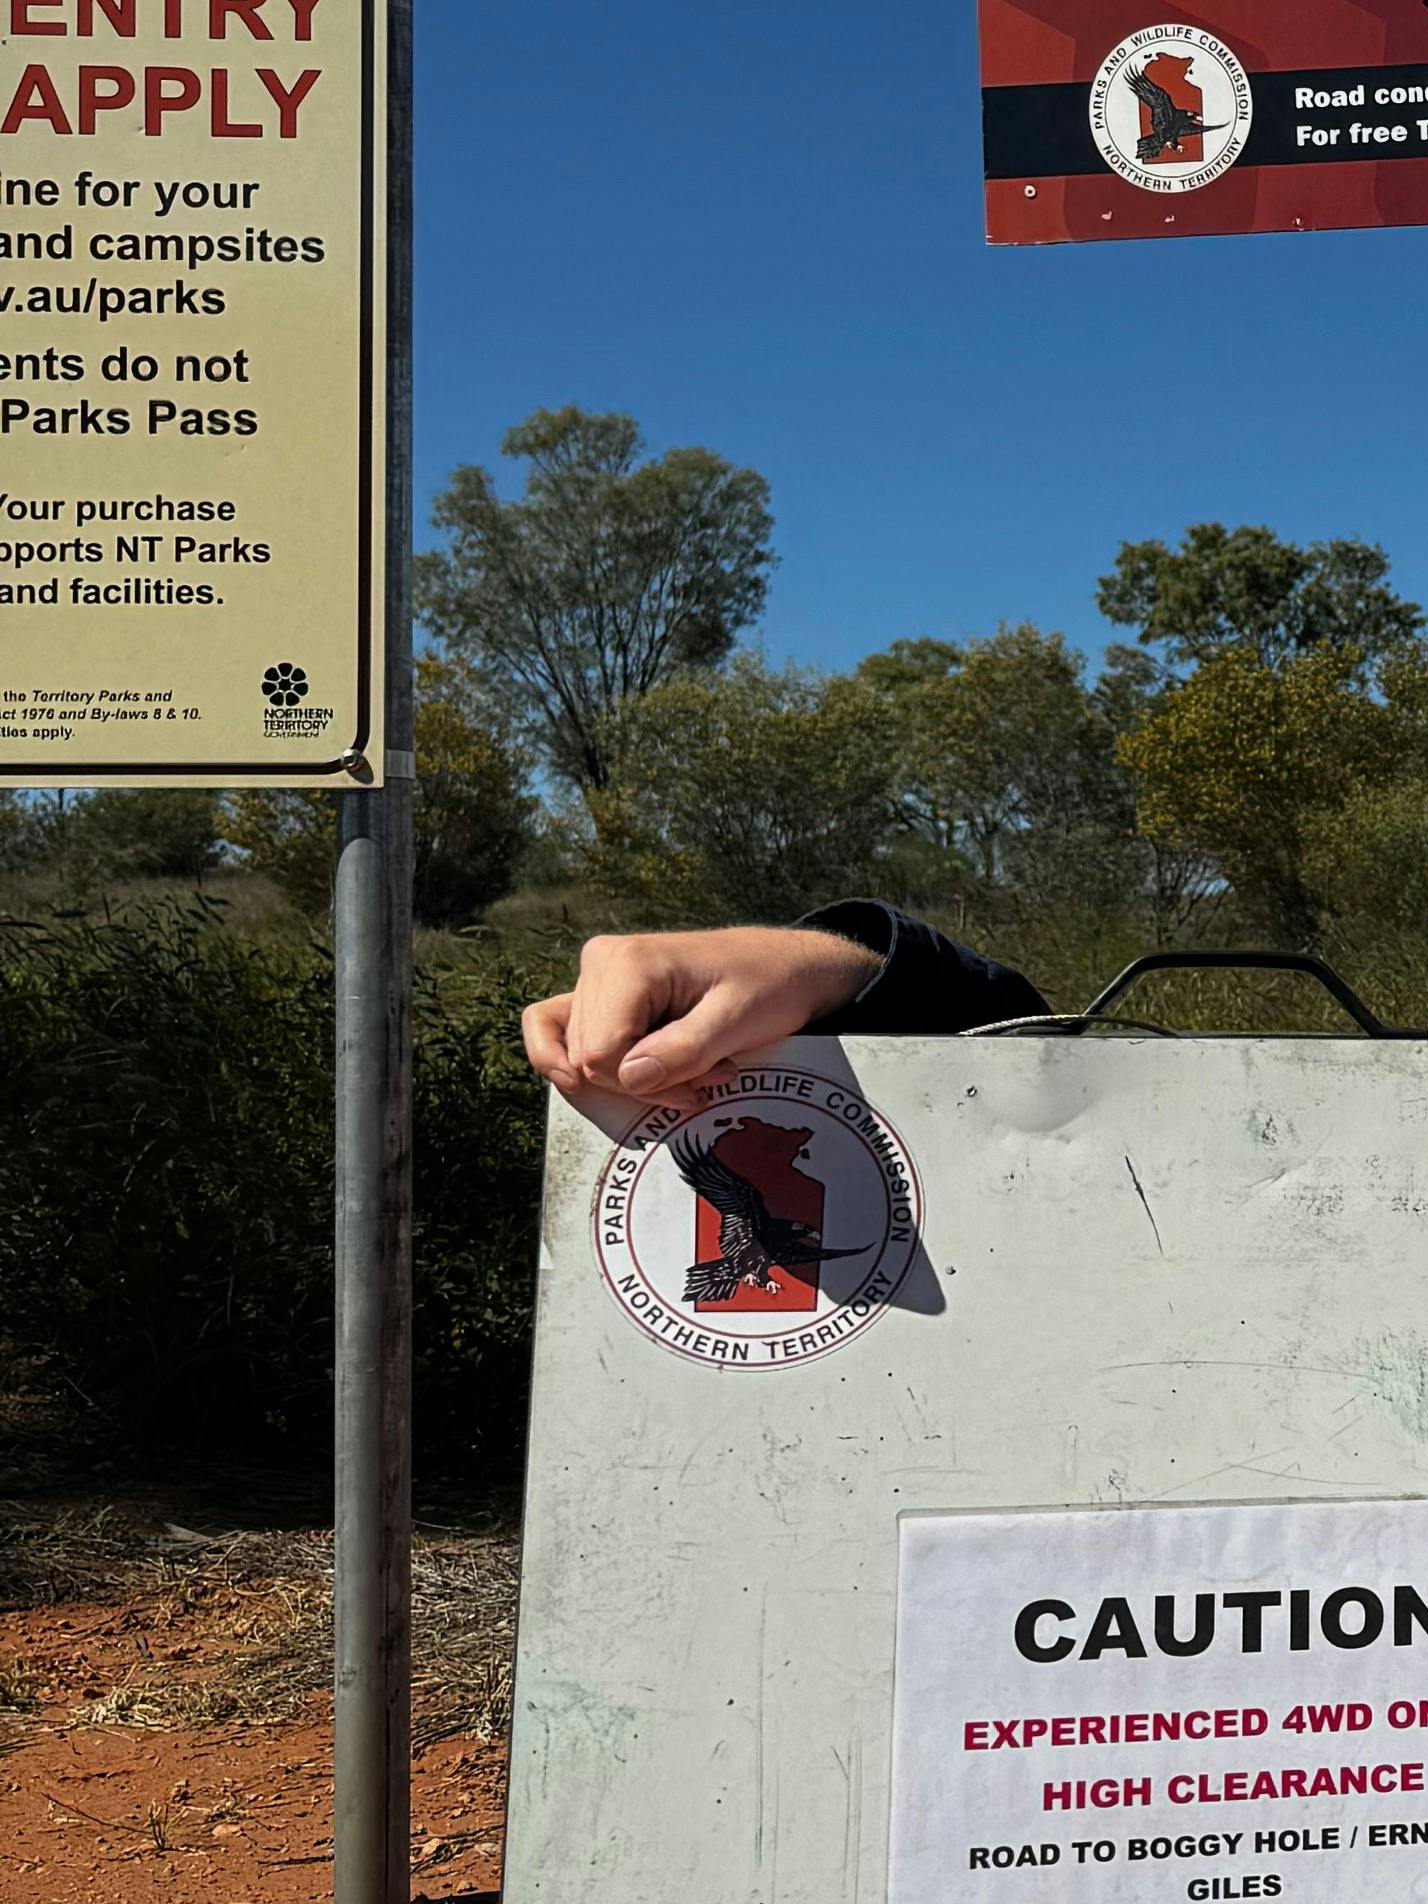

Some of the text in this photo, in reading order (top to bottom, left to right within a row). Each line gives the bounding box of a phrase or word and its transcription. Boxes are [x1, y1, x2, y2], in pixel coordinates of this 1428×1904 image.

[1093, 26, 1249, 130] PARKS AND WILDLIFE COMMISSION
[1296, 85, 1364, 108] Road
[0, 64, 322, 138] APPLY
[1104, 137, 1242, 191] NORTHERN TERRITORY
[0, 171, 259, 216] ne for your
[0, 225, 324, 270] and campsites
[102, 347, 158, 381] do
[176, 349, 249, 382] not
[2, 399, 257, 435] Parks Pass
[77, 495, 235, 527] purchase
[117, 536, 163, 562] NT
[175, 537, 270, 562] Parks
[0, 578, 223, 604] and facilities.
[605, 1158, 637, 1245] PARKS
[635, 1108, 682, 1153] AND
[826, 1093, 913, 1243] COMMISSION
[617, 1269, 894, 1360] NORTHERN TERRITORY
[964, 1709, 1268, 1750] EXPERIENCED
[1282, 1704, 1372, 1734] 4WD
[1044, 1763, 1424, 1811] HIGH CLEARANCE
[970, 1844, 1060, 1869] ROAD
[1072, 1841, 1115, 1863] TO
[1128, 1833, 1243, 1860] BOGGY
[1255, 1828, 1339, 1853] HOLE
[1188, 1875, 1281, 1900] GILES
